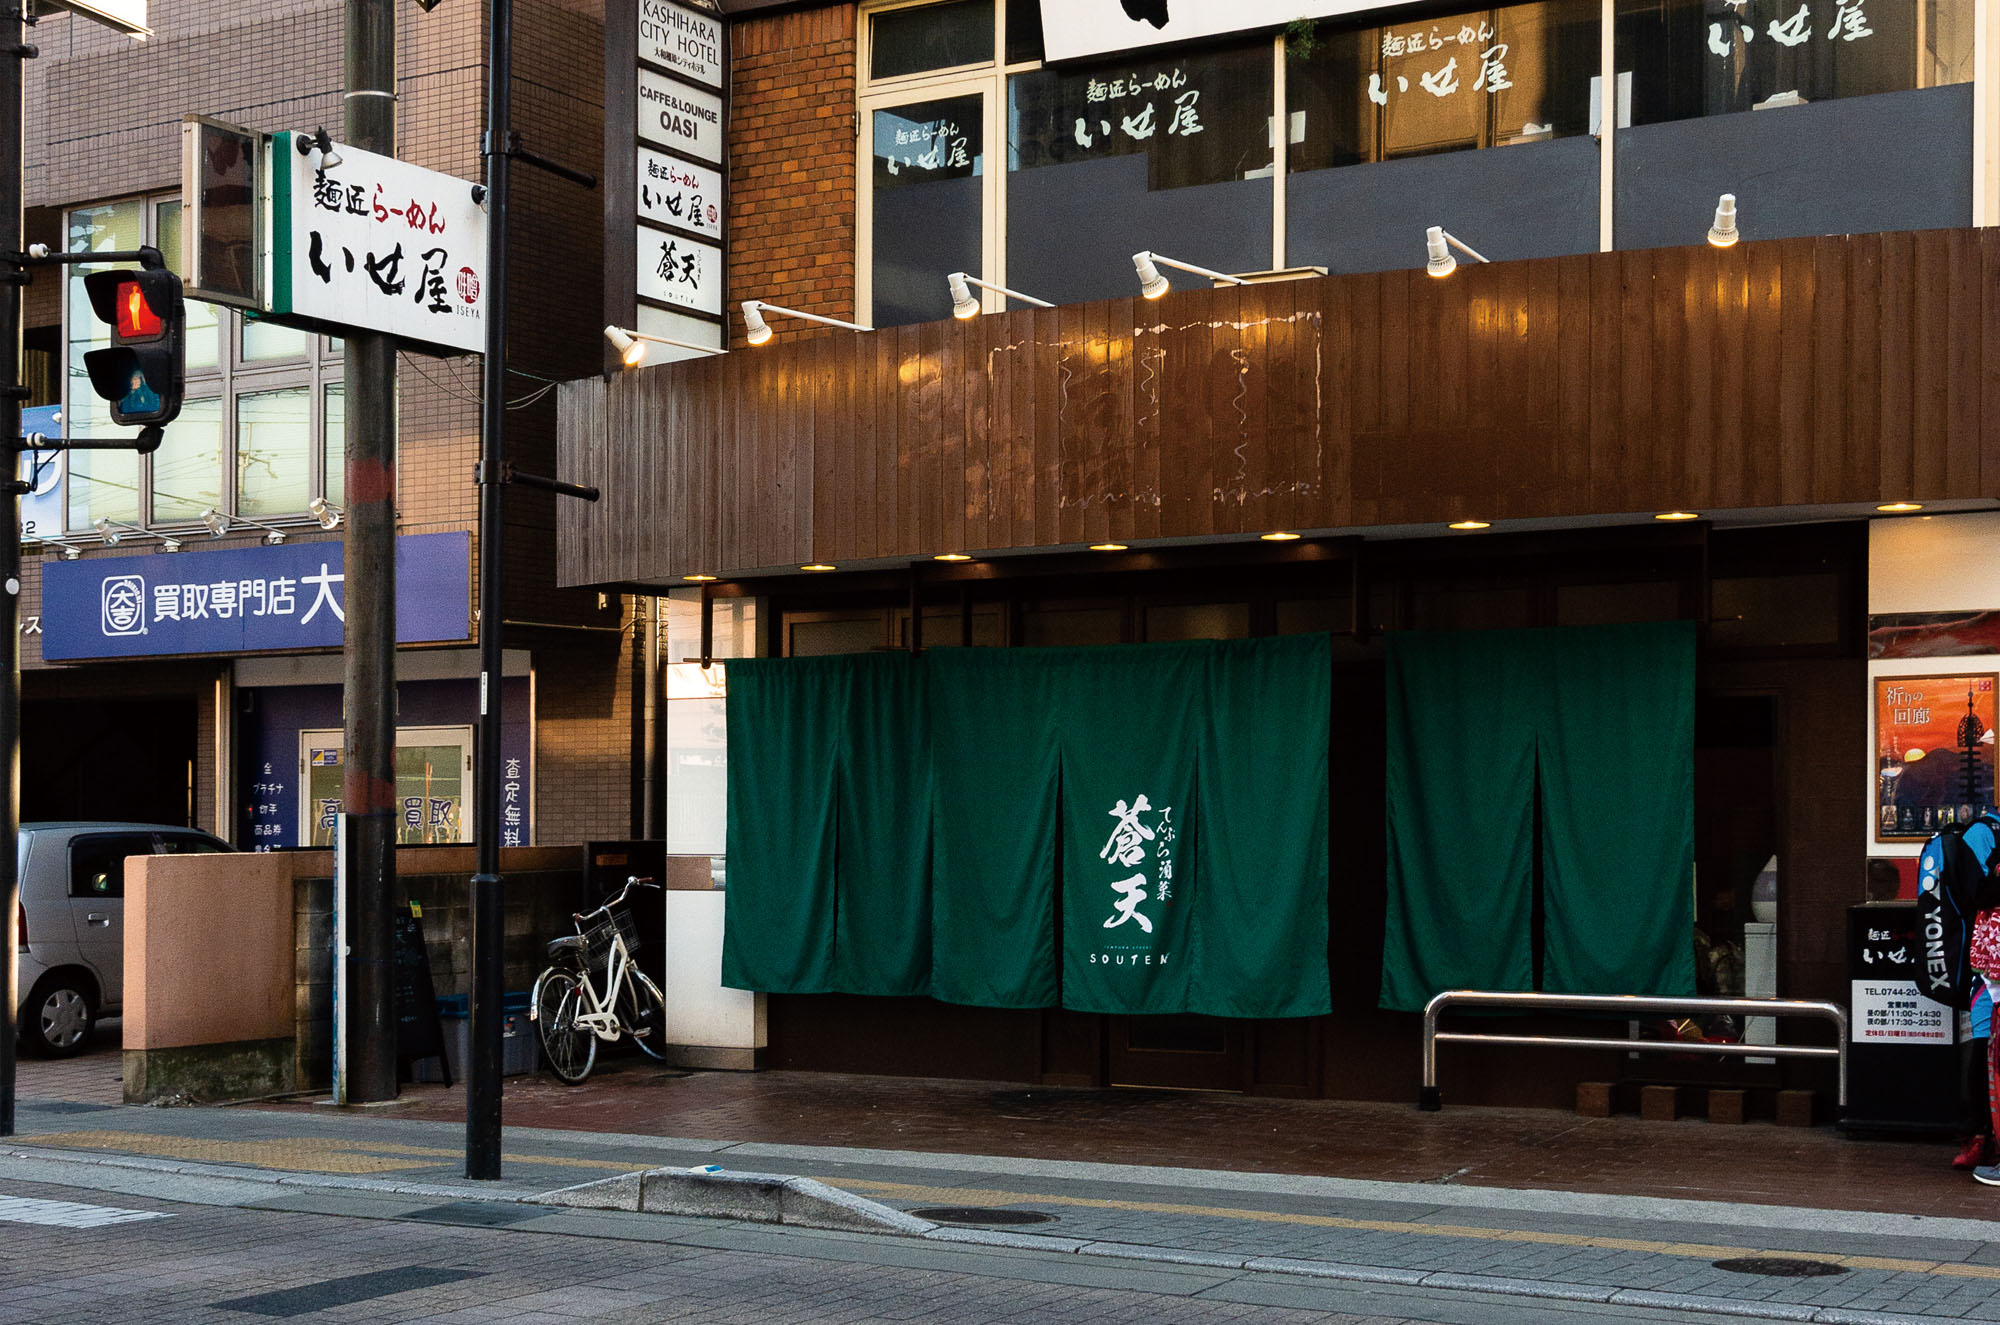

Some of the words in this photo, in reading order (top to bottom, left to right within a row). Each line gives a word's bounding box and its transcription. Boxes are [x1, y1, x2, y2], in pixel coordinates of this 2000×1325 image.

[640, 20, 670, 45] CITY
[677, 34, 719, 66] HOTEL
[643, 0, 716, 44] KASHIHARA
[1707, 0, 1874, 58] いせ屋
[1368, 43, 1513, 106] いせ屋
[640, 85, 718, 124] CAFFE&LOUNGE
[659, 110, 698, 140] OASI
[1074, 90, 1204, 149] いせ屋
[887, 137, 970, 176] いせ屋
[642, 184, 705, 227] いせ屋
[309, 230, 453, 314] いせ屋
[656, 240, 698, 290] 蒼天
[456, 304, 481, 320] ISEYA
[1886, 686, 1924, 706] 祈りの
[1893, 706, 1931, 725] 回廊
[504, 758, 521, 847] 査定無料
[1099, 793, 1156, 934] 蒼天
[1089, 951, 1171, 967] SOUTEN
[1862, 946, 1916, 964] いせ
[1924, 905, 1952, 991] YONEX
[1864, 987, 1923, 997] TEL.0744-20-
